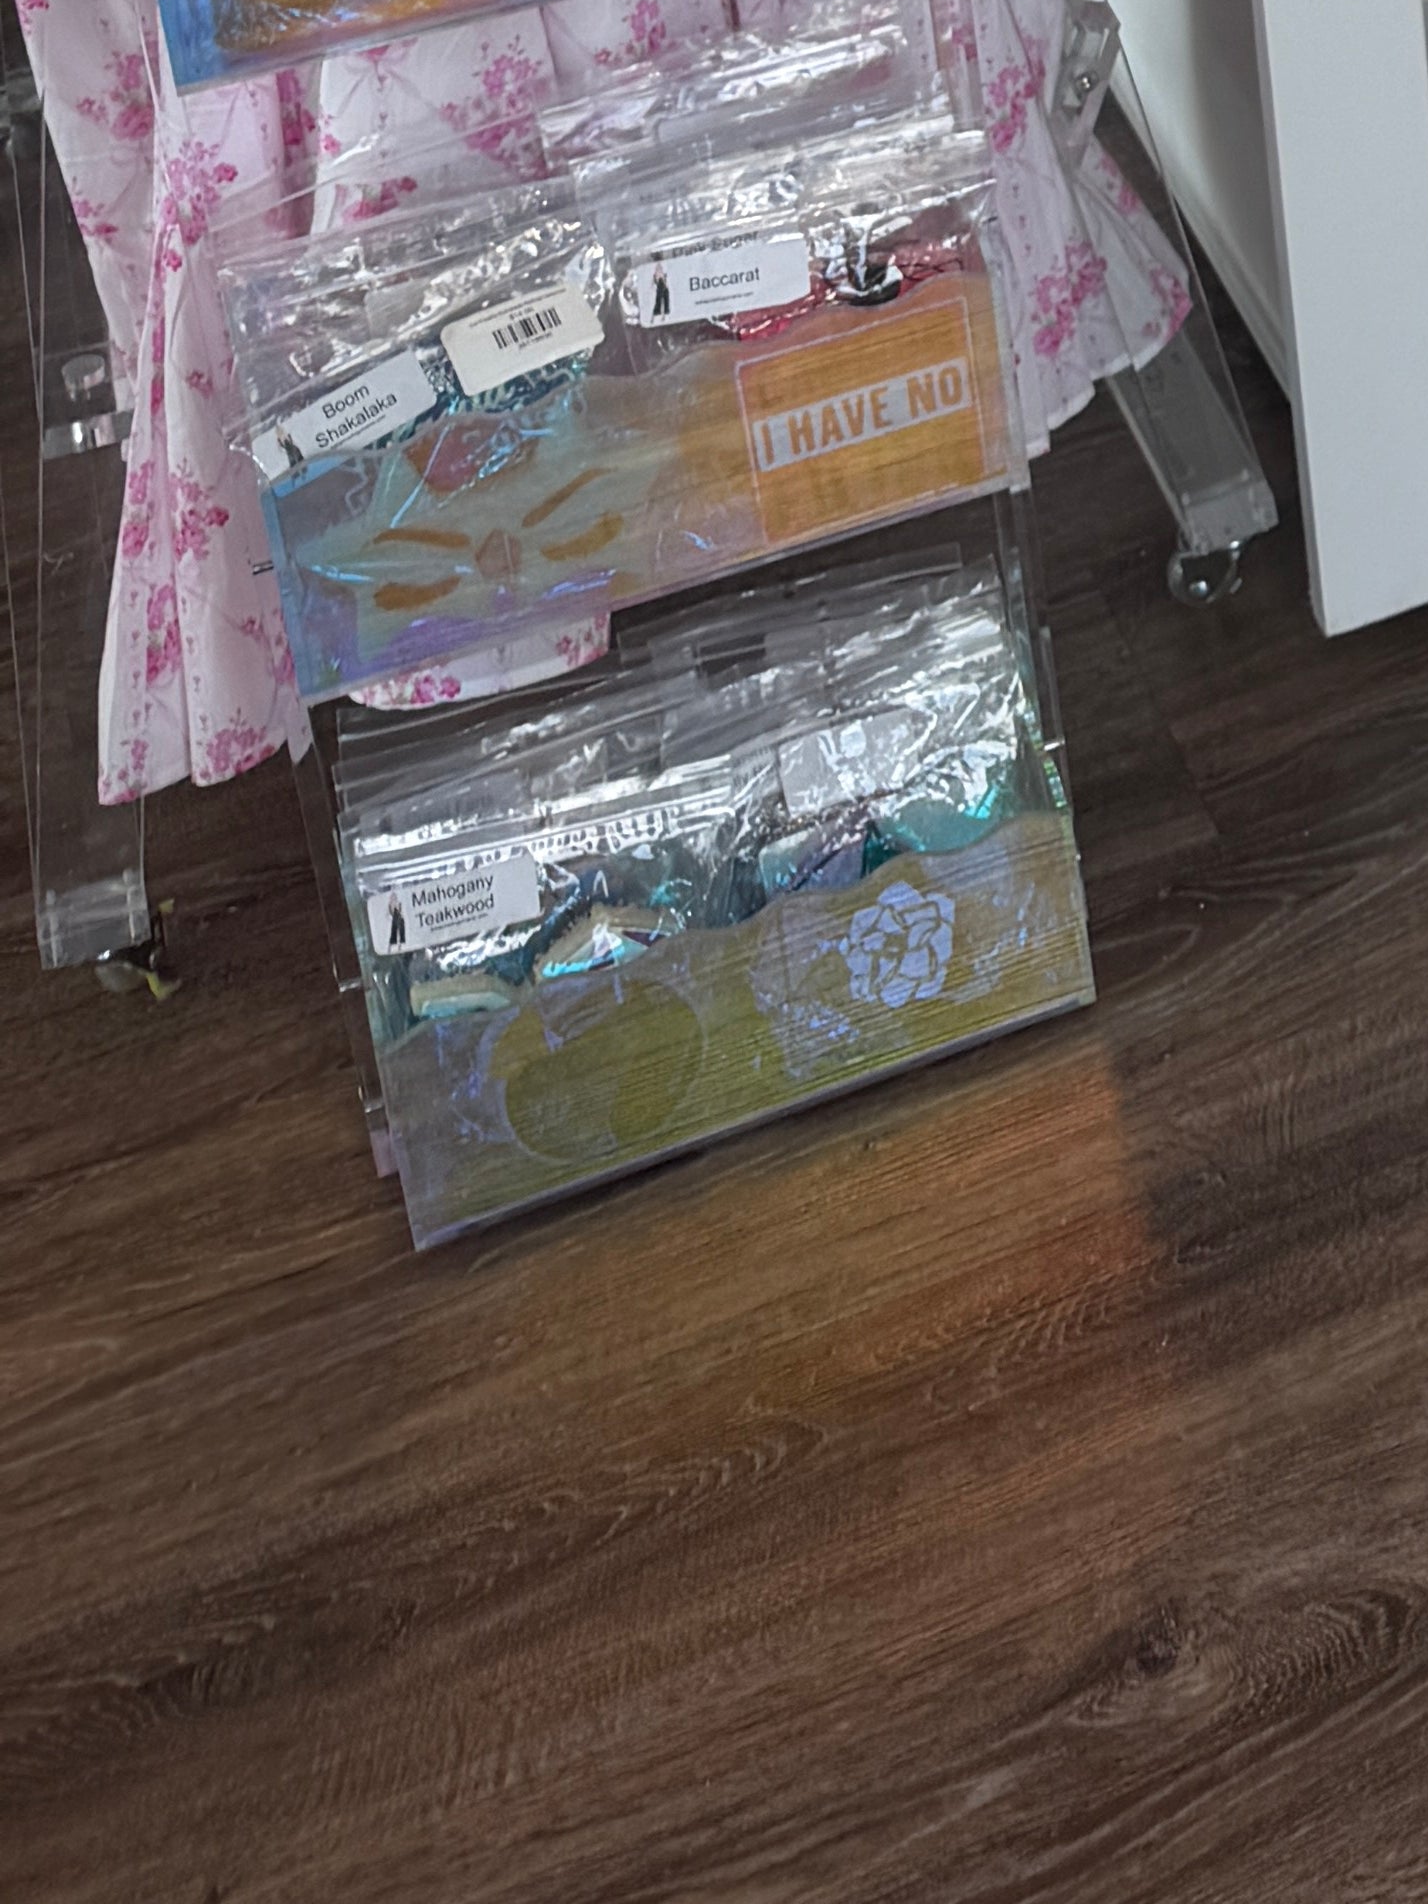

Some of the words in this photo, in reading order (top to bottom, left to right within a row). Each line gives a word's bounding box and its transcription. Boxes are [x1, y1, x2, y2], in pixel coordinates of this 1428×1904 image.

[689, 267, 760, 292] Baccarat
[322, 384, 370, 419] Boom
[760, 421, 775, 465] I
[787, 386, 893, 457] HAVE
[906, 365, 963, 419] NO
[315, 392, 398, 449] Shakalaka
[411, 875, 494, 908] Mahogany
[415, 893, 495, 928] Teakwood
